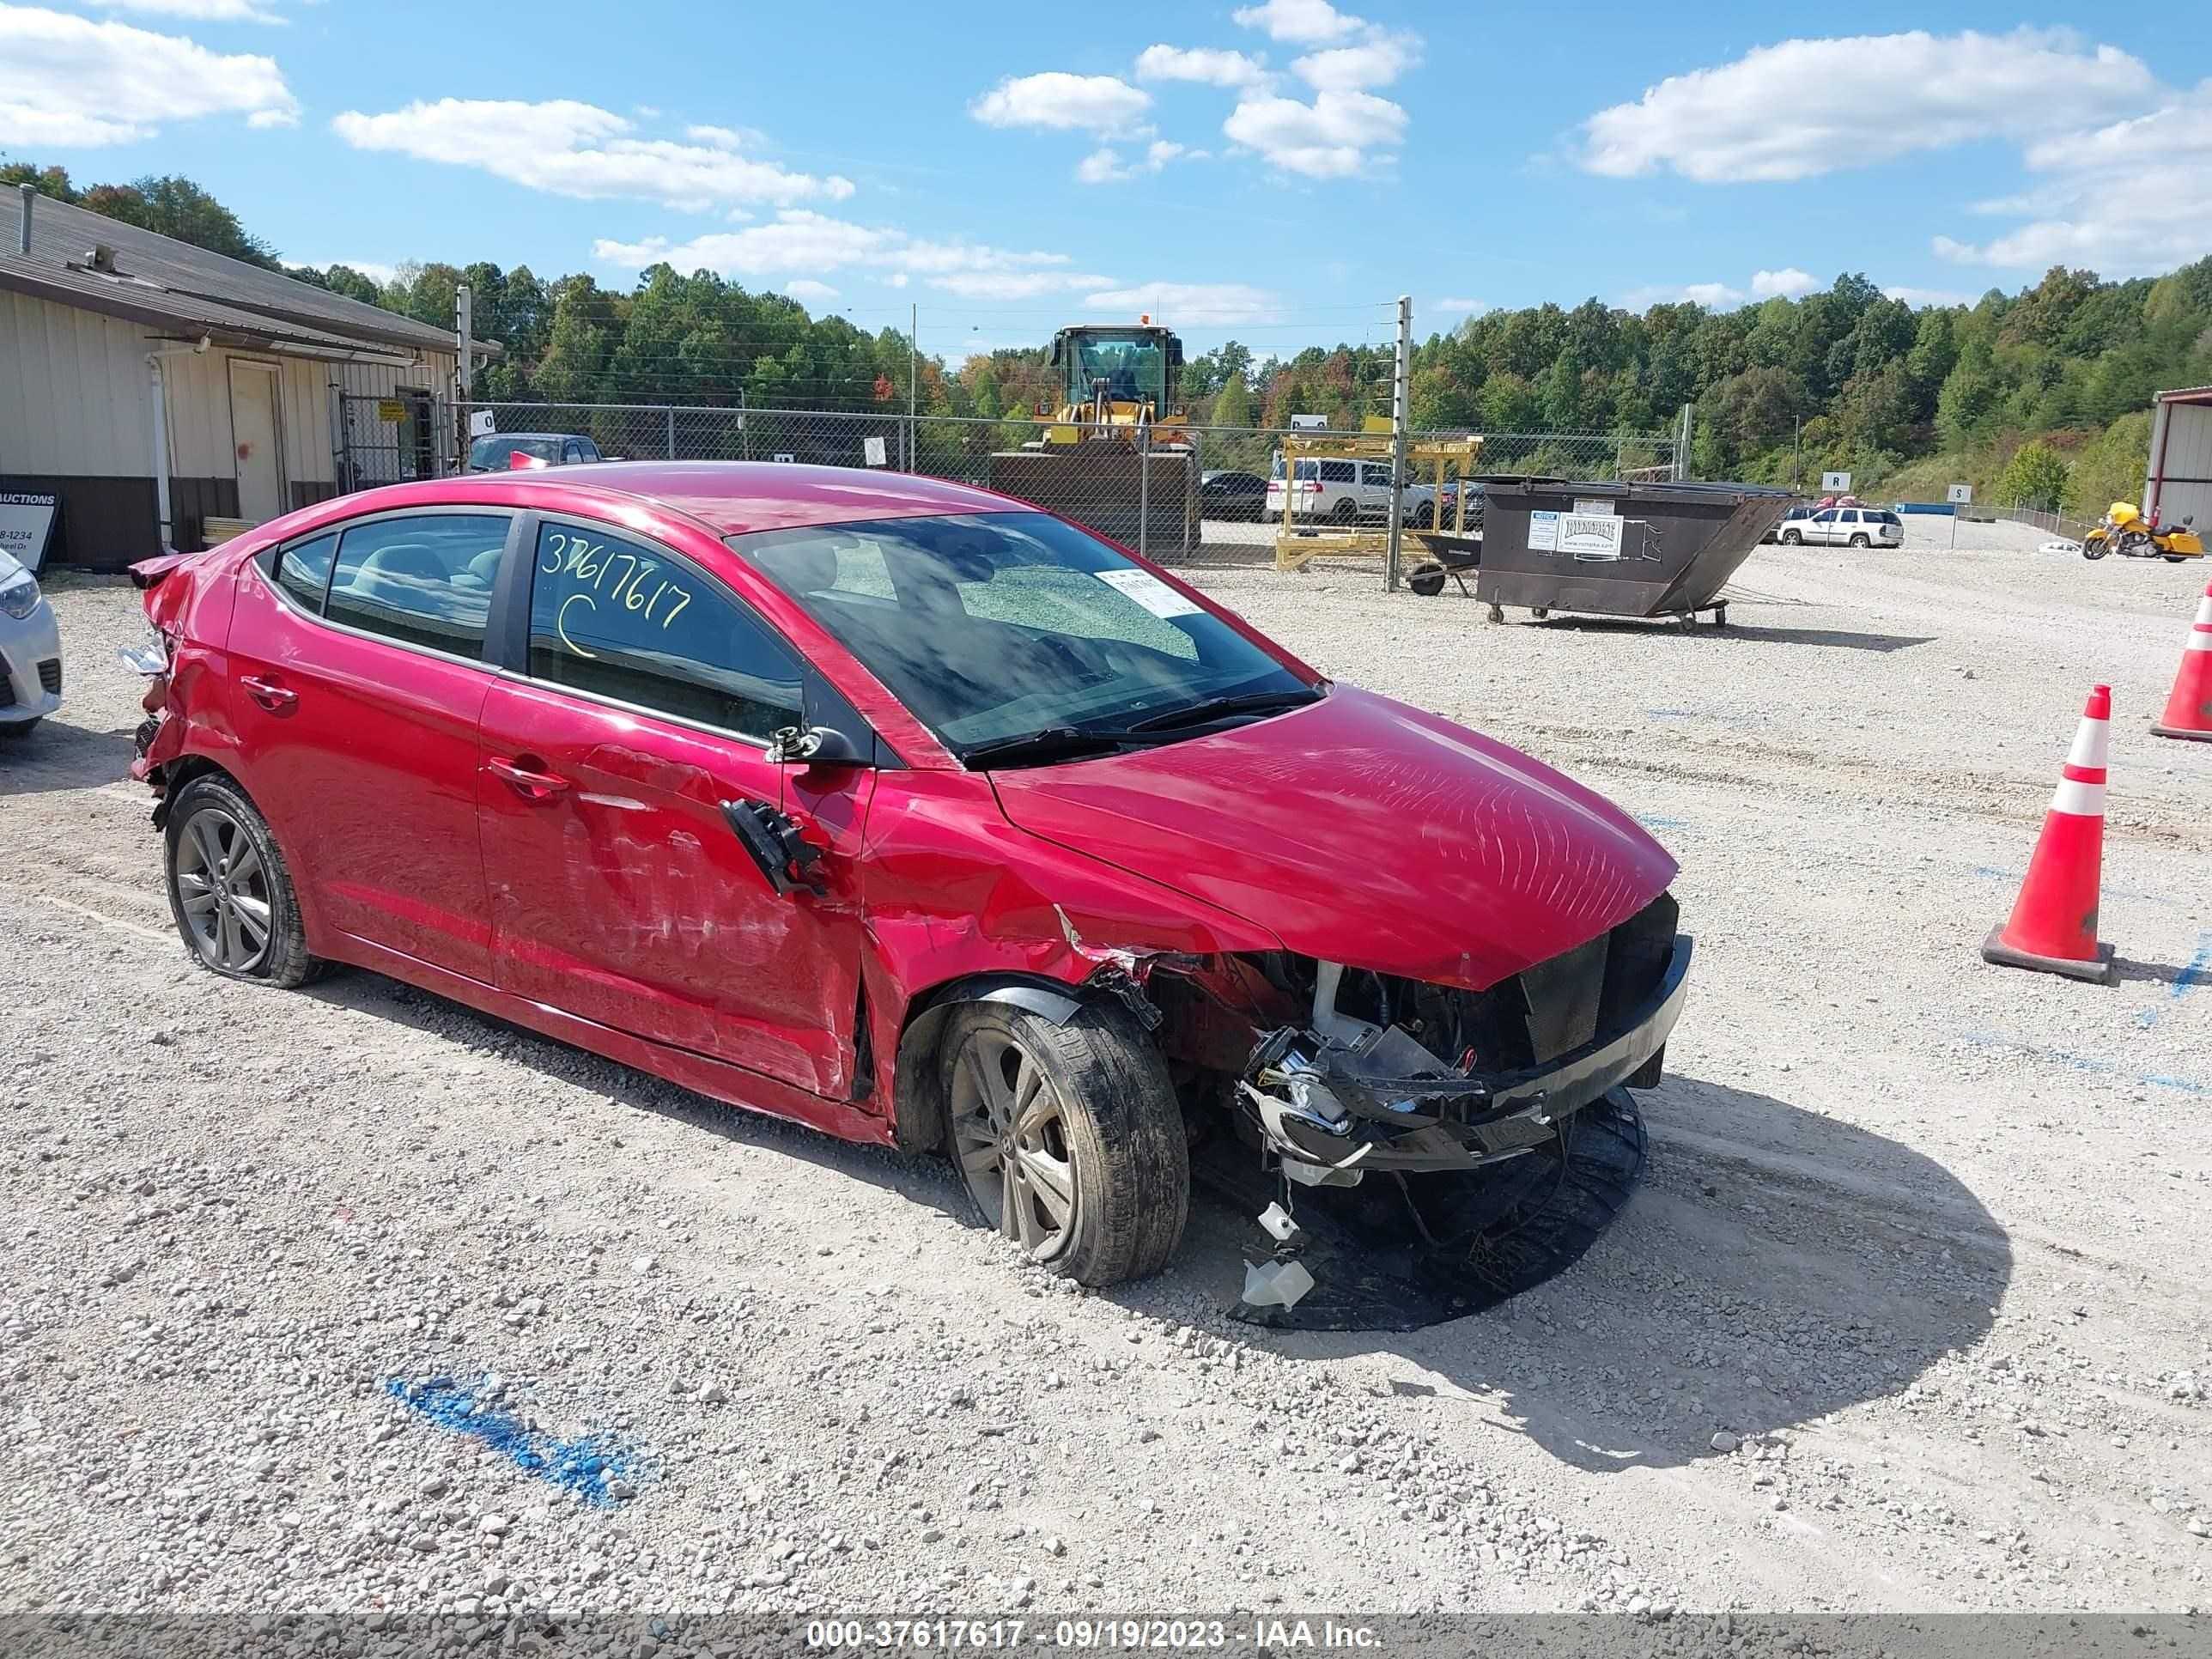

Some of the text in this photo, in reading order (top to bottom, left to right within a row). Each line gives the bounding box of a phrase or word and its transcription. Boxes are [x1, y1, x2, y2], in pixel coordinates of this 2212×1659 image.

[1832, 477, 1840, 487] R
[1956, 489, 1962, 498] S
[542, 534, 692, 630] 37617617
[558, 593, 599, 659] C
